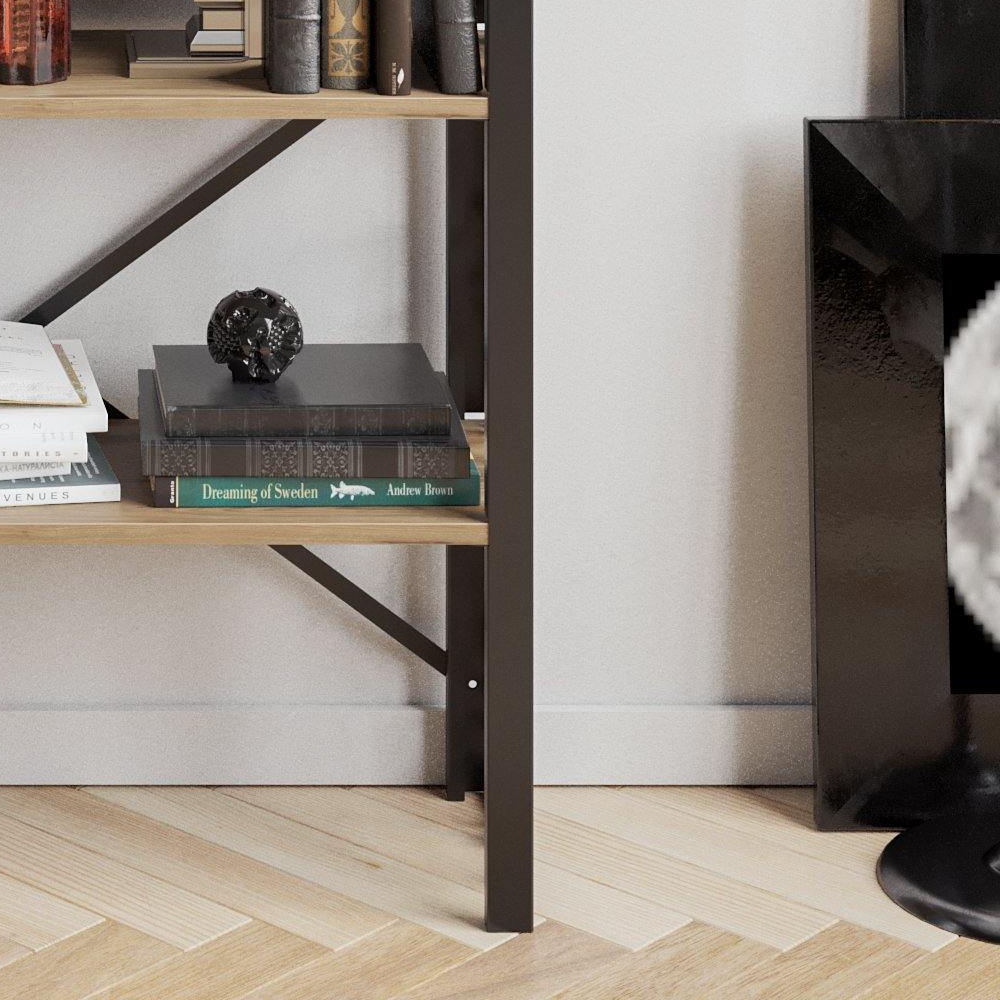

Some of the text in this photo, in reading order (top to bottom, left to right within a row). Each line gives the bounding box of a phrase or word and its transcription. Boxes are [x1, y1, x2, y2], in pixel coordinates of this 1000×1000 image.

[202, 483, 318, 503] Dreaming of Sweden
[387, 483, 454, 497] Andrew Brown
